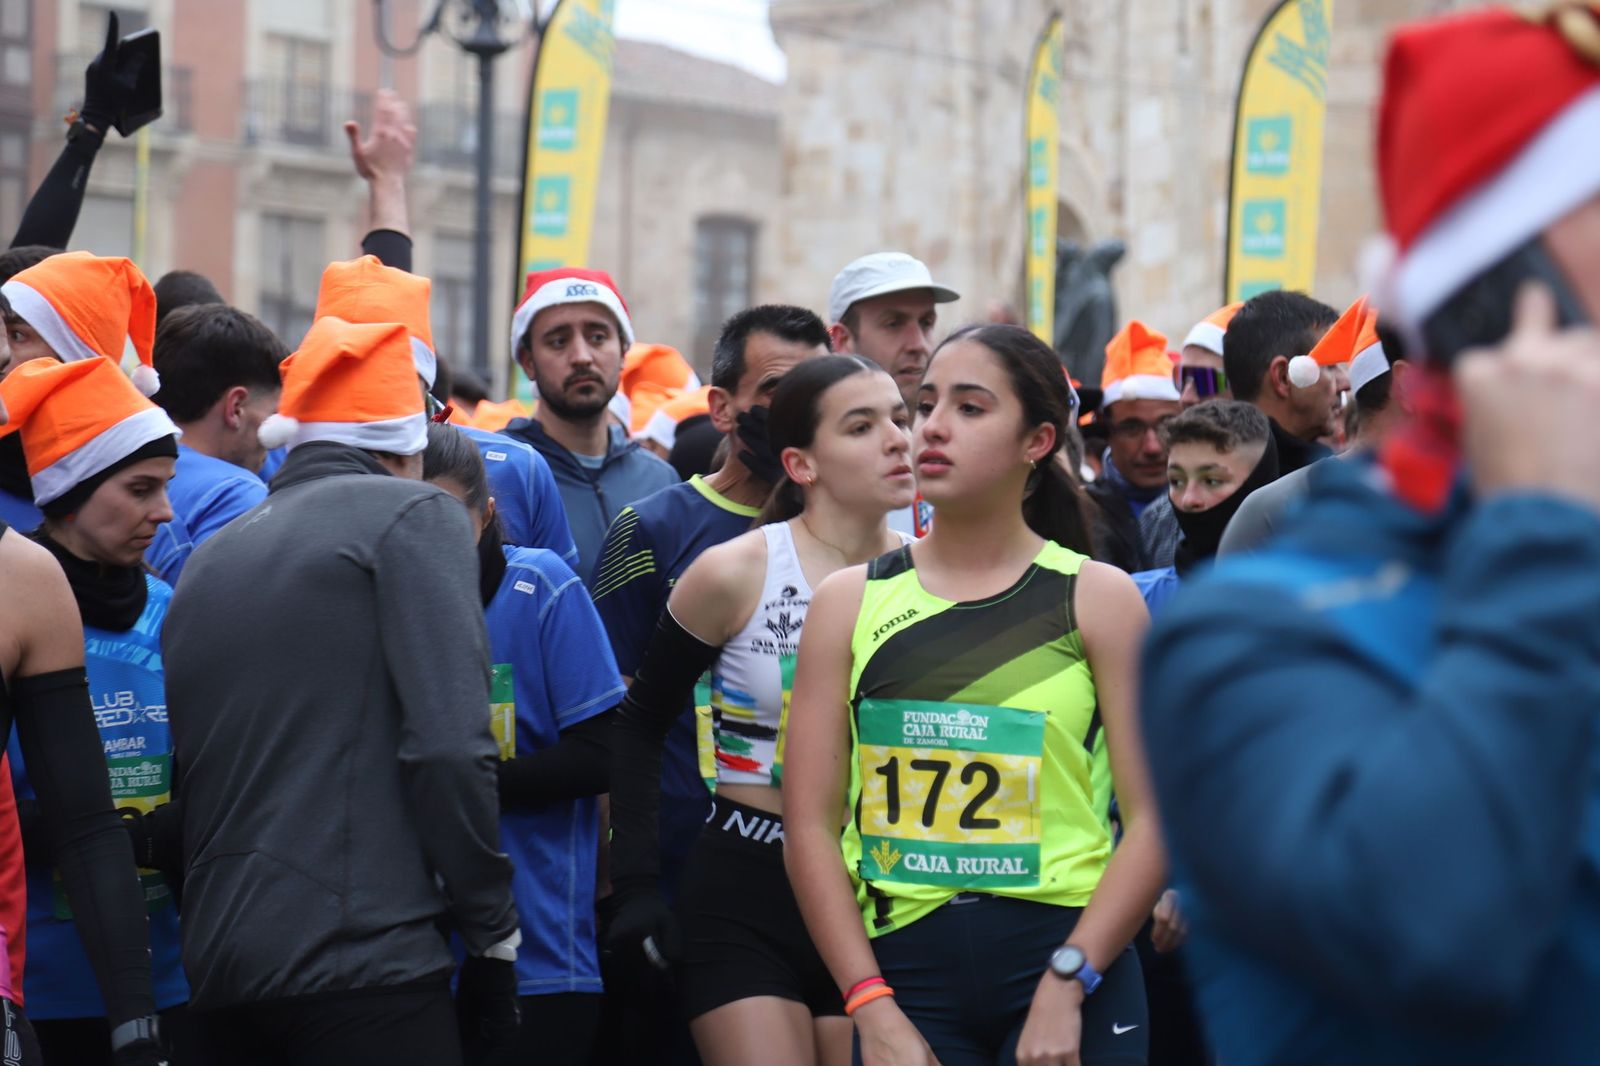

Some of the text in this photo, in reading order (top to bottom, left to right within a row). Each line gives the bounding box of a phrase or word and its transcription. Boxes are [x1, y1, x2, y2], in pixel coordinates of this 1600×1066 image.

[90, 691, 134, 711] LUB
[903, 723, 988, 740] CAJA RURAL
[103, 736, 147, 754] AMBAR
[917, 738, 949, 747] ZAMORA
[875, 755, 1002, 830] 172
[722, 809, 785, 844] NIK
[903, 853, 1029, 875] CAJA RURAL
